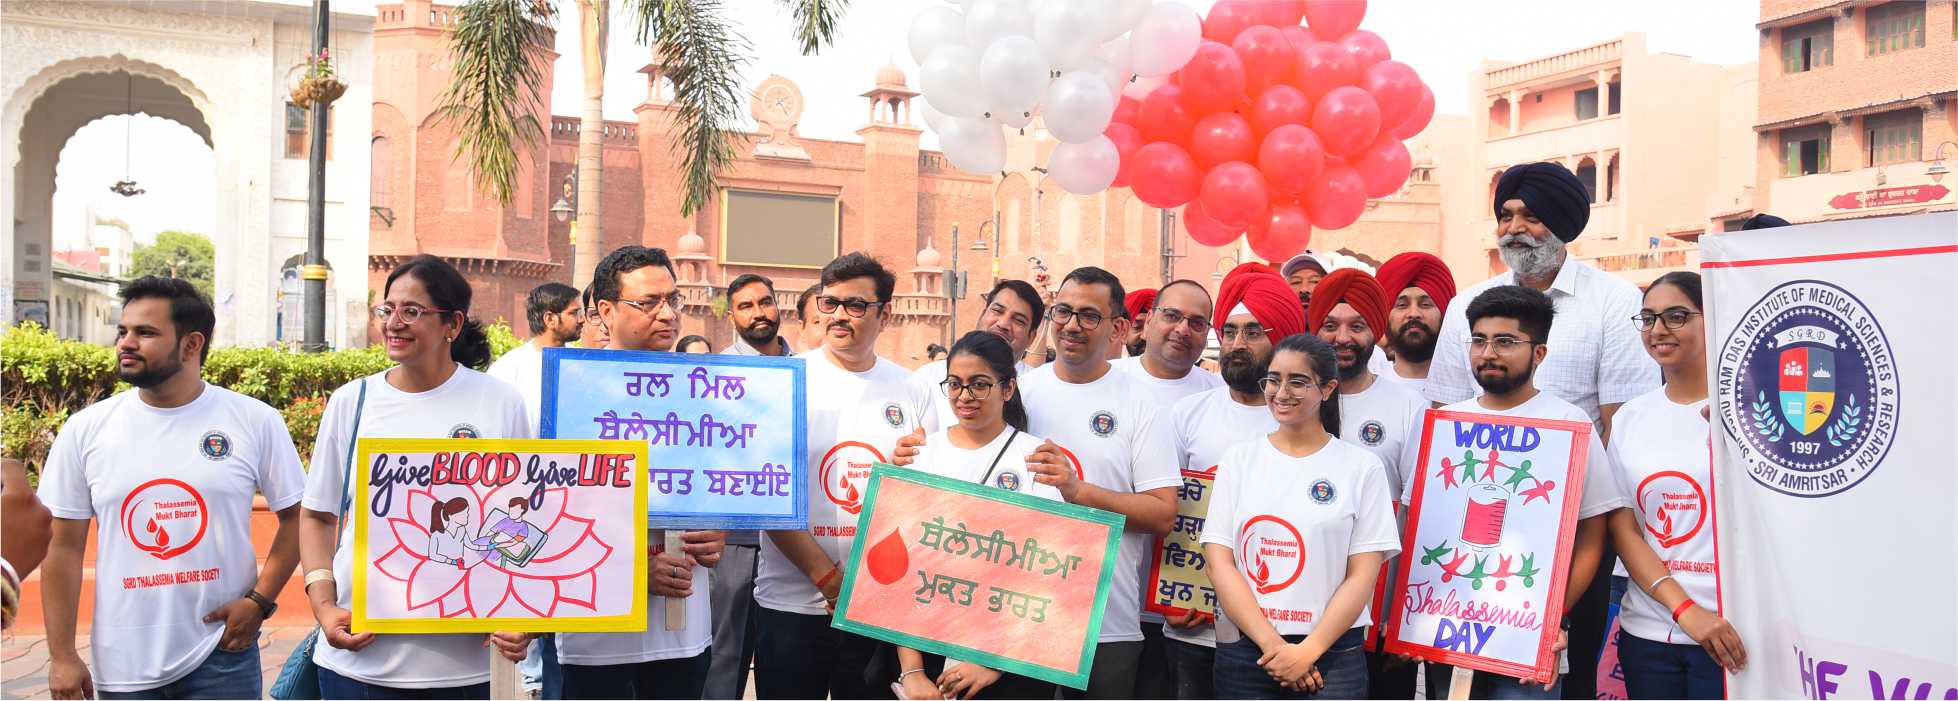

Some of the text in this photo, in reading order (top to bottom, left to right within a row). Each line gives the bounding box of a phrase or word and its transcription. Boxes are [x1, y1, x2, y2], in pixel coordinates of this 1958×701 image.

[1791, 288, 1805, 302] OF
[1809, 287, 1856, 321] MEDICAL
[1742, 291, 1789, 339] INSTITUTE
[1731, 337, 1746, 363] DAS
[1855, 316, 1892, 382] SCIENCES
[624, 367, 746, 400] ਰਲ ਮਿਲ
[1720, 366, 1733, 395] RAM
[1880, 387, 1894, 397] &
[1454, 421, 1541, 452] WORLD
[1789, 441, 1820, 455] 1997
[1858, 402, 1894, 469] RESEARCH
[430, 452, 521, 487] BLOOD
[577, 453, 636, 487] LIFE
[648, 463, 791, 496] ਾਰਤ ਬਣਾਈਏ
[1753, 461, 1848, 491] SRI AMRITSAR
[154, 499, 197, 510] Thalassemia
[155, 509, 198, 521] Mukt Bharat
[1259, 536, 1298, 548] Thalassemia
[1259, 547, 1297, 558] Mukt Bharat
[137, 573, 175, 589] THALASSEMIA
[175, 569, 200, 584] WELFARE
[916, 570, 978, 606] ਮੁਕਤ
[1290, 609, 1313, 623] SOCIETY
[1403, 580, 1544, 631] Thalassemia
[1433, 617, 1496, 656] DAY
[1793, 646, 1848, 700] HE
